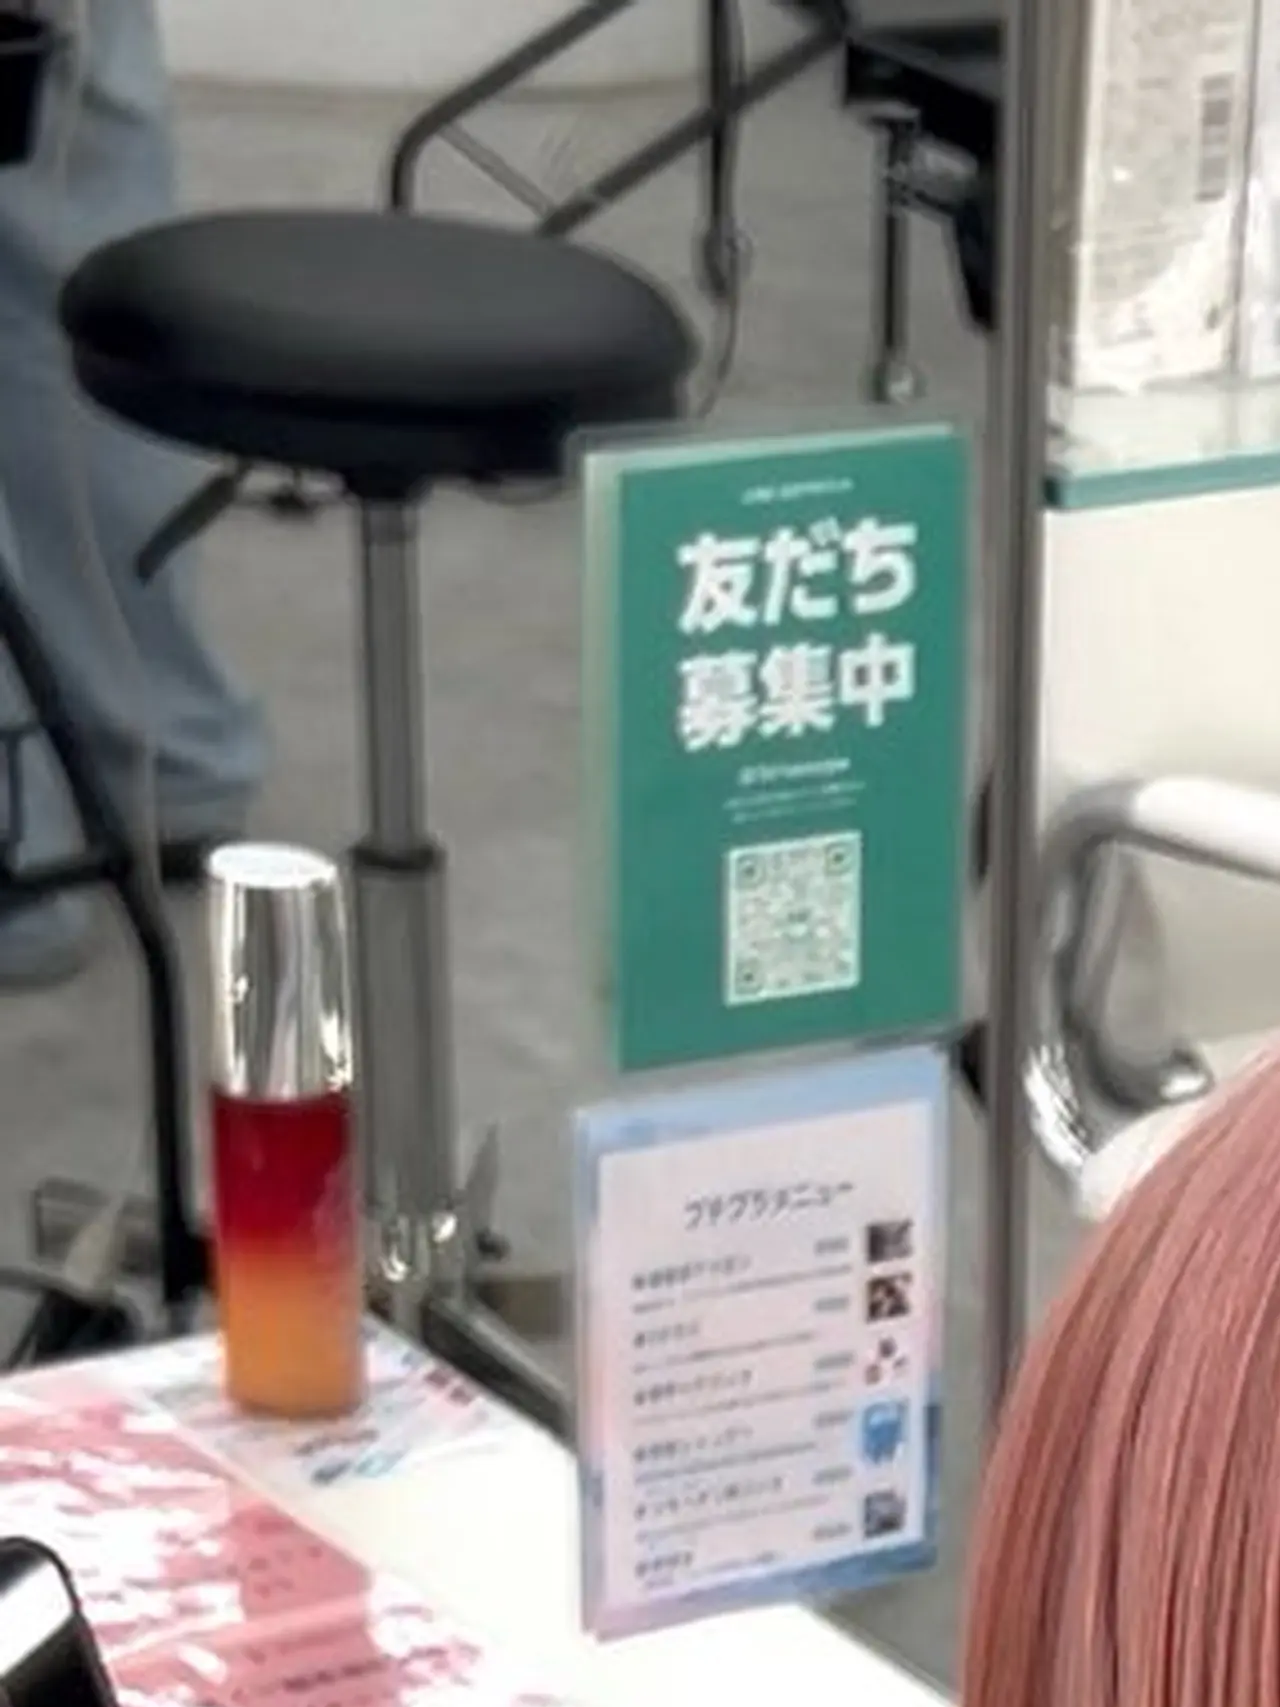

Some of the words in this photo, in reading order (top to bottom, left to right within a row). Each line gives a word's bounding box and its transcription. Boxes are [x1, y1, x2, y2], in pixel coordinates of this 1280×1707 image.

[678, 516, 918, 634] 友だち
[678, 632, 916, 752] 募集中
